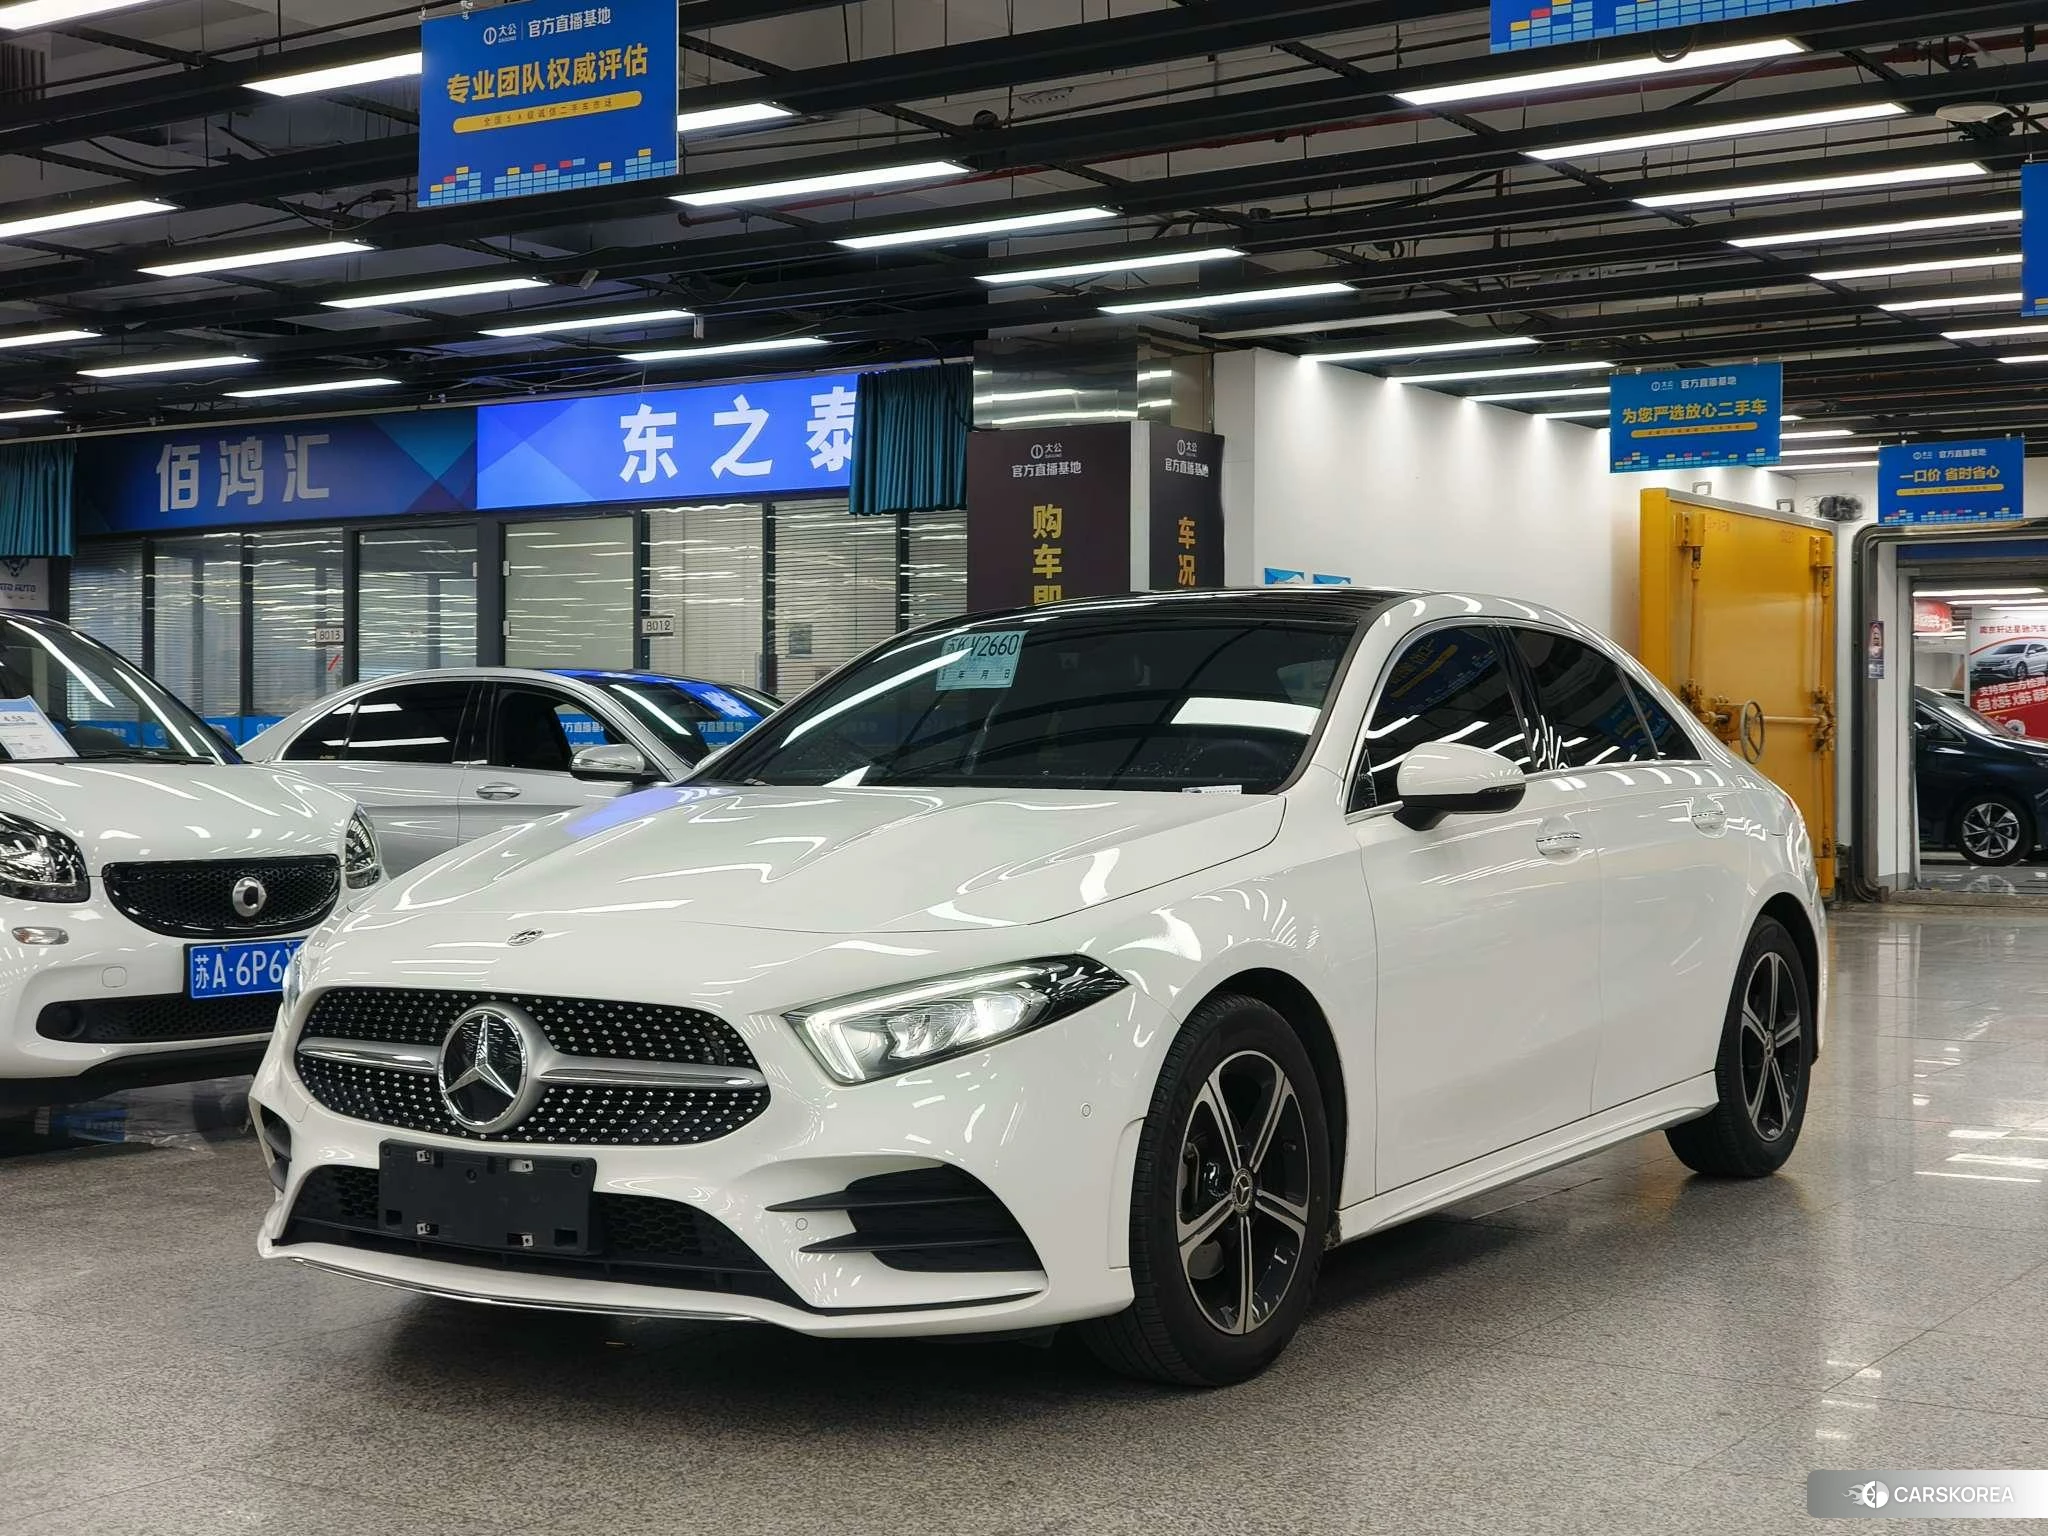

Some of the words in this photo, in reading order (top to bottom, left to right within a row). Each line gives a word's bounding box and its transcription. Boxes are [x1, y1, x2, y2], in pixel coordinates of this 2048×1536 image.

[528, 7, 611, 38] 官方直播基地
[447, 43, 649, 103] 专业团队权威评估
[619, 386, 857, 484] 东之泰
[156, 434, 330, 512] 佰鸿汇
[1011, 461, 1081, 478] 官方直播基地
[1165, 458, 1209, 478] 官方直播基地
[1900, 468, 1941, 483] 一口价
[1945, 465, 2000, 482] 省时省心
[1178, 517, 1196, 586] 车况
[320, 630, 341, 640] 8013
[647, 620, 671, 631] 8012
